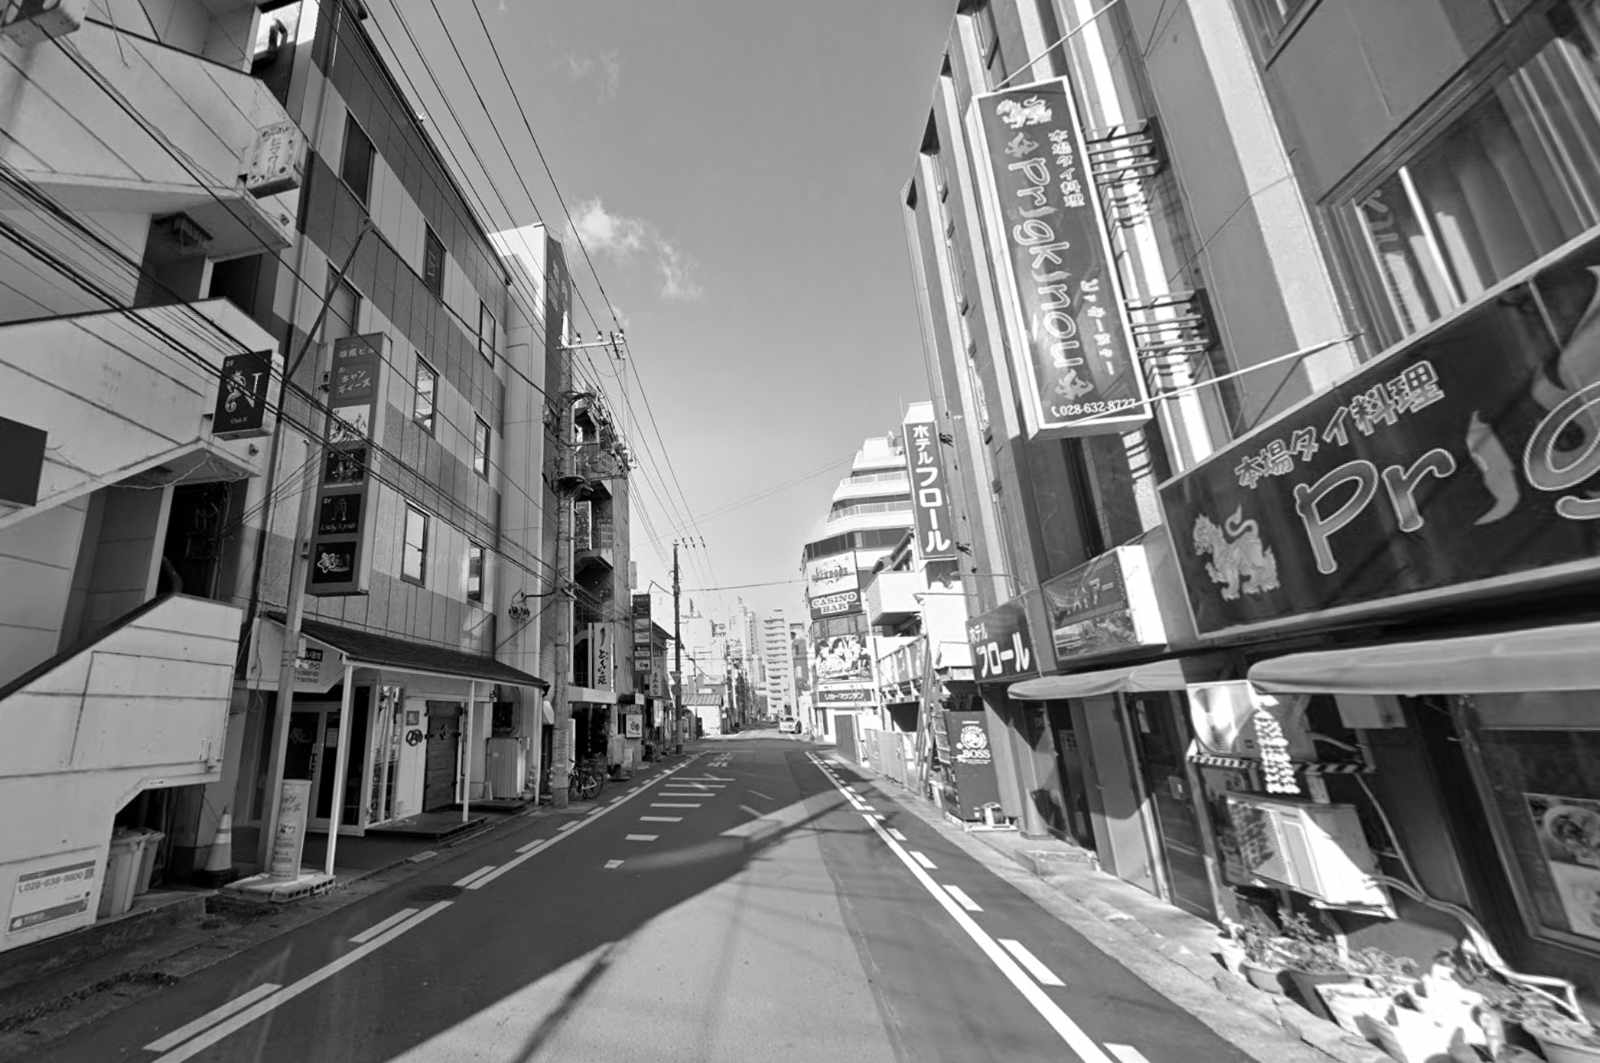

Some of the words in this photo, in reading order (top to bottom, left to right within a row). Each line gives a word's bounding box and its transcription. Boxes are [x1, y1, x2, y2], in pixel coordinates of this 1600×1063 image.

[1235, 360, 1445, 489] 本場タイ料理
[913, 425, 951, 553] ホテルフロール
[812, 592, 857, 609] CASINO
[821, 603, 848, 615] BAR
[976, 632, 1030, 678] フロール
[962, 749, 991, 759] BOSS
